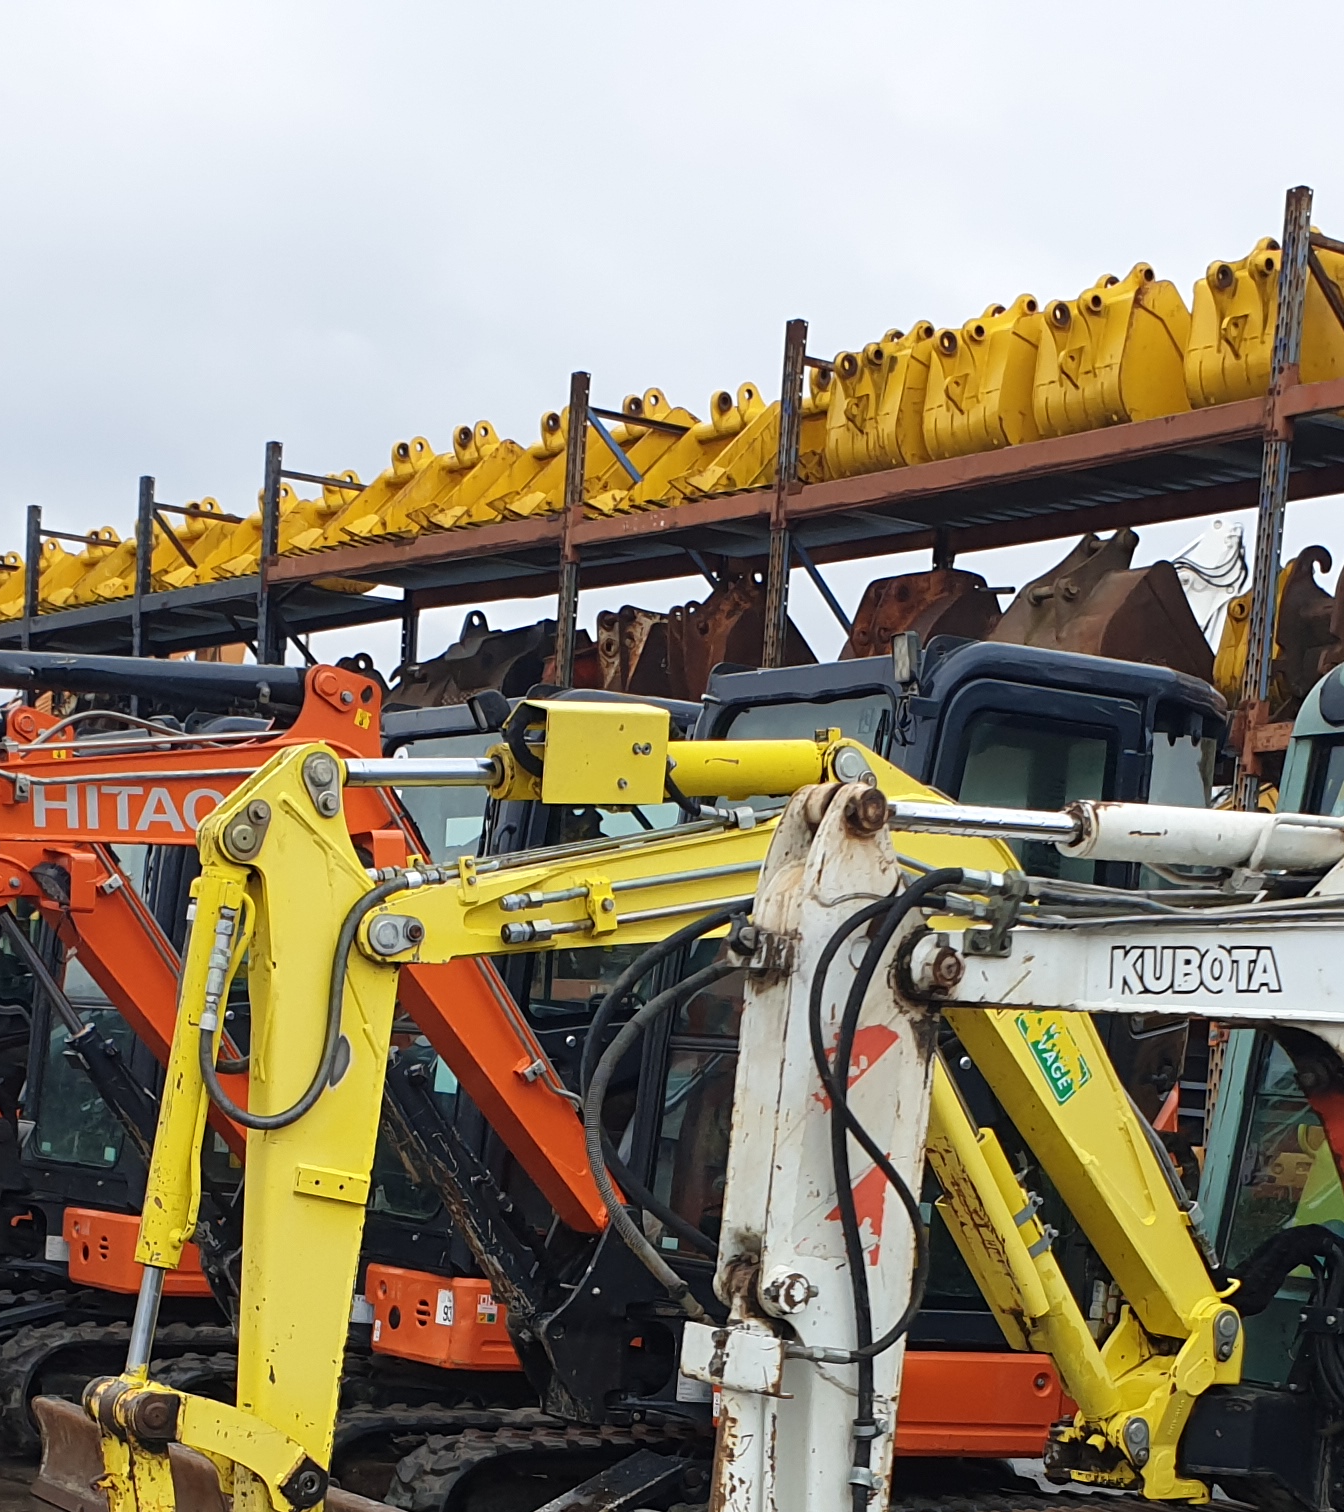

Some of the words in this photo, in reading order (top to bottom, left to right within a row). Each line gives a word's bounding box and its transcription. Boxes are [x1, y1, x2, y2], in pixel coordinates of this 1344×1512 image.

[33, 784, 225, 833] HITAC
[1110, 944, 1282, 995] KUBOTA
[1037, 1034, 1073, 1090] VAGE
